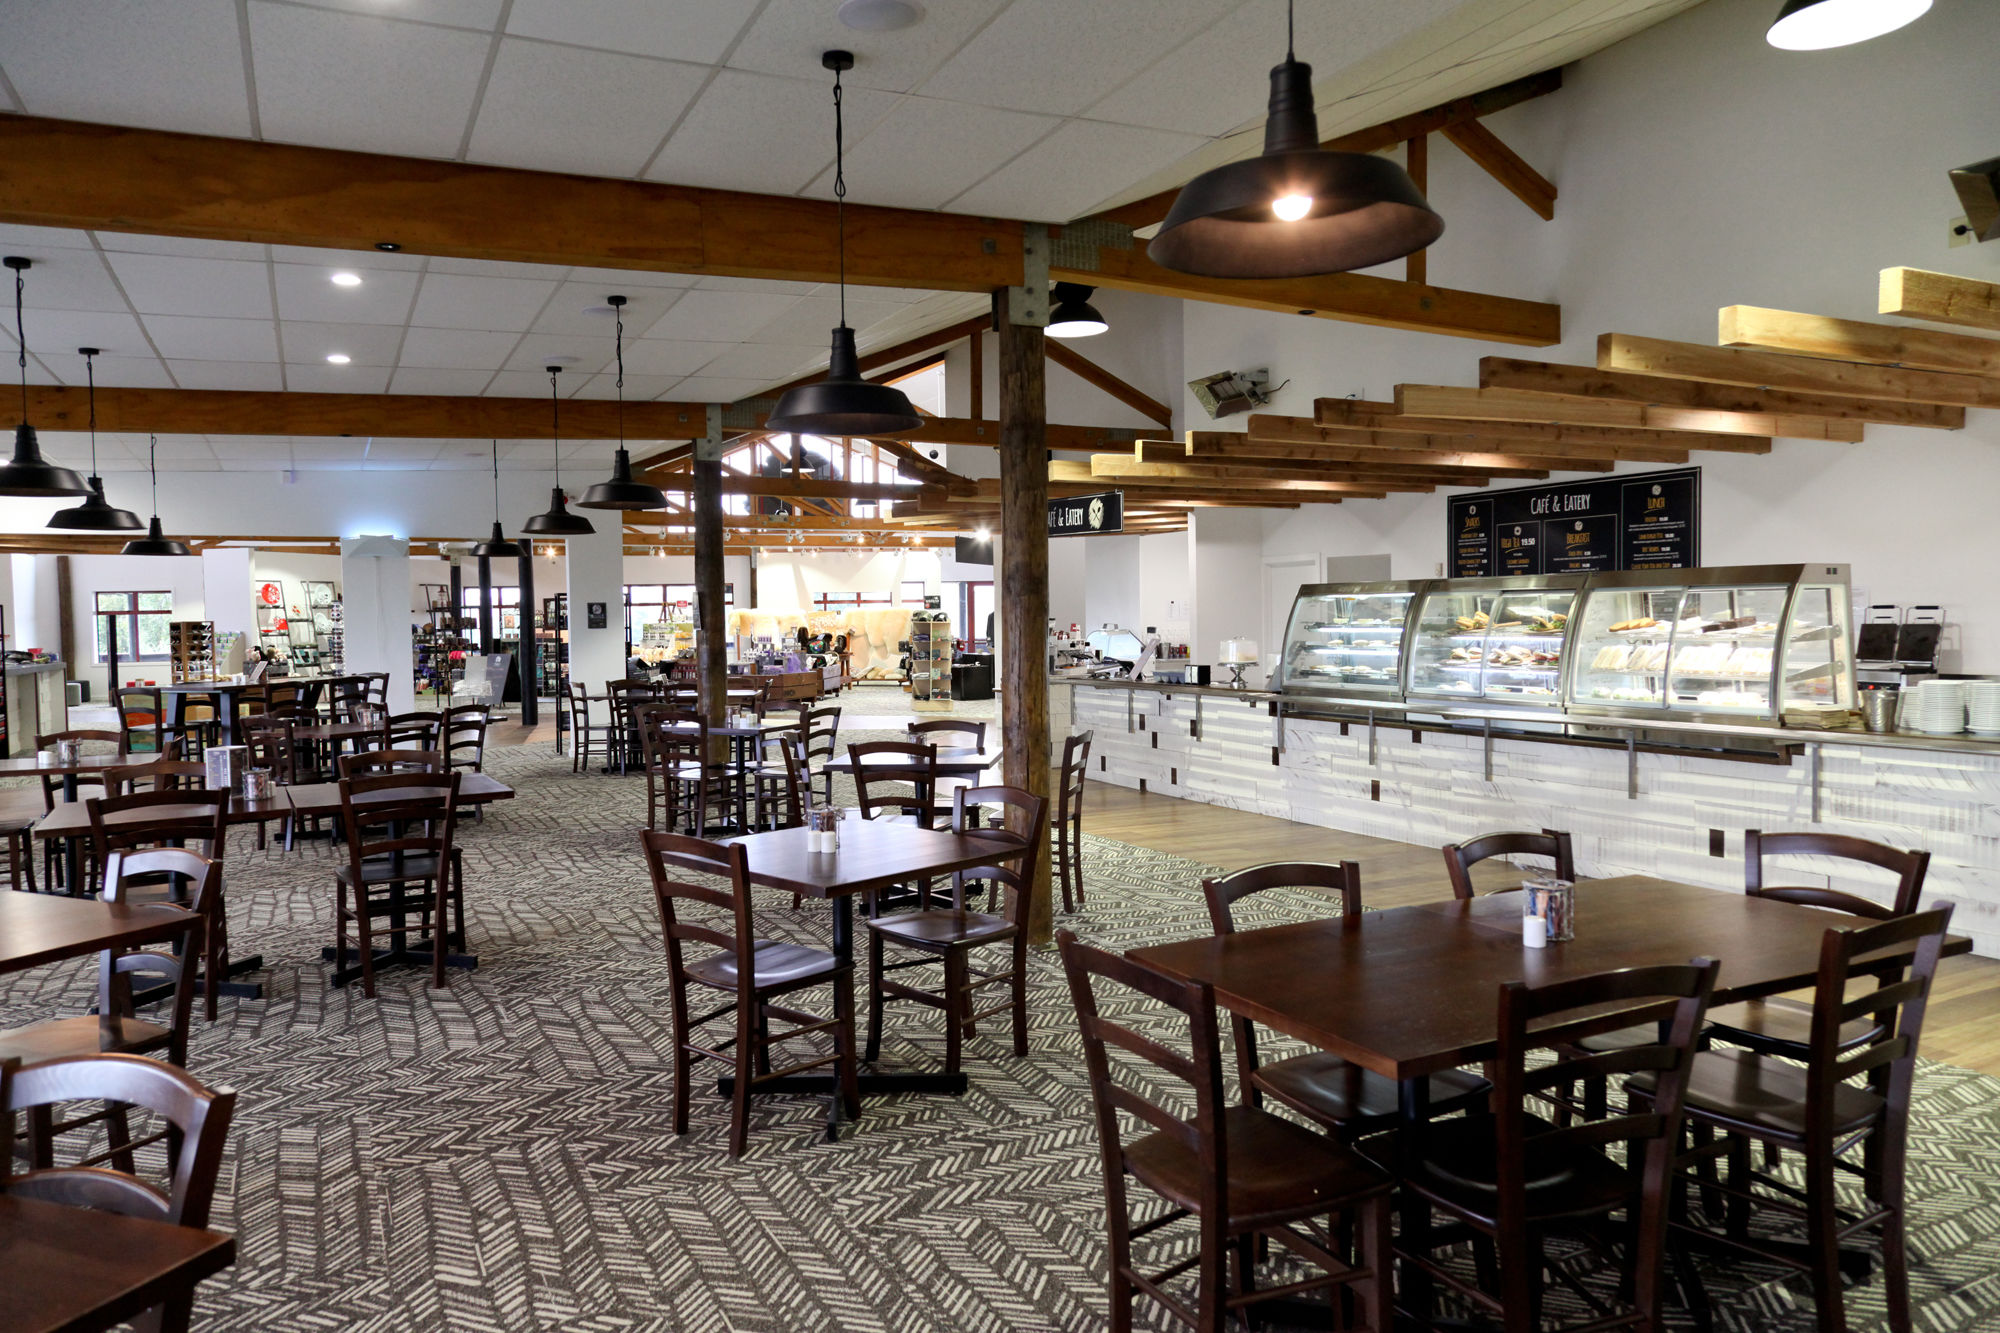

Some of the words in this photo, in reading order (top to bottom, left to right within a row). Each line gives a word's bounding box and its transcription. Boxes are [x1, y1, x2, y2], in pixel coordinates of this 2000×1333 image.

[1530, 494, 1550, 514] CAFÉ
[1552, 496, 1560, 512] &
[1564, 494, 1591, 512] EATERY
[1058, 508, 1064, 526] &
[1066, 508, 1084, 526] EATERY
